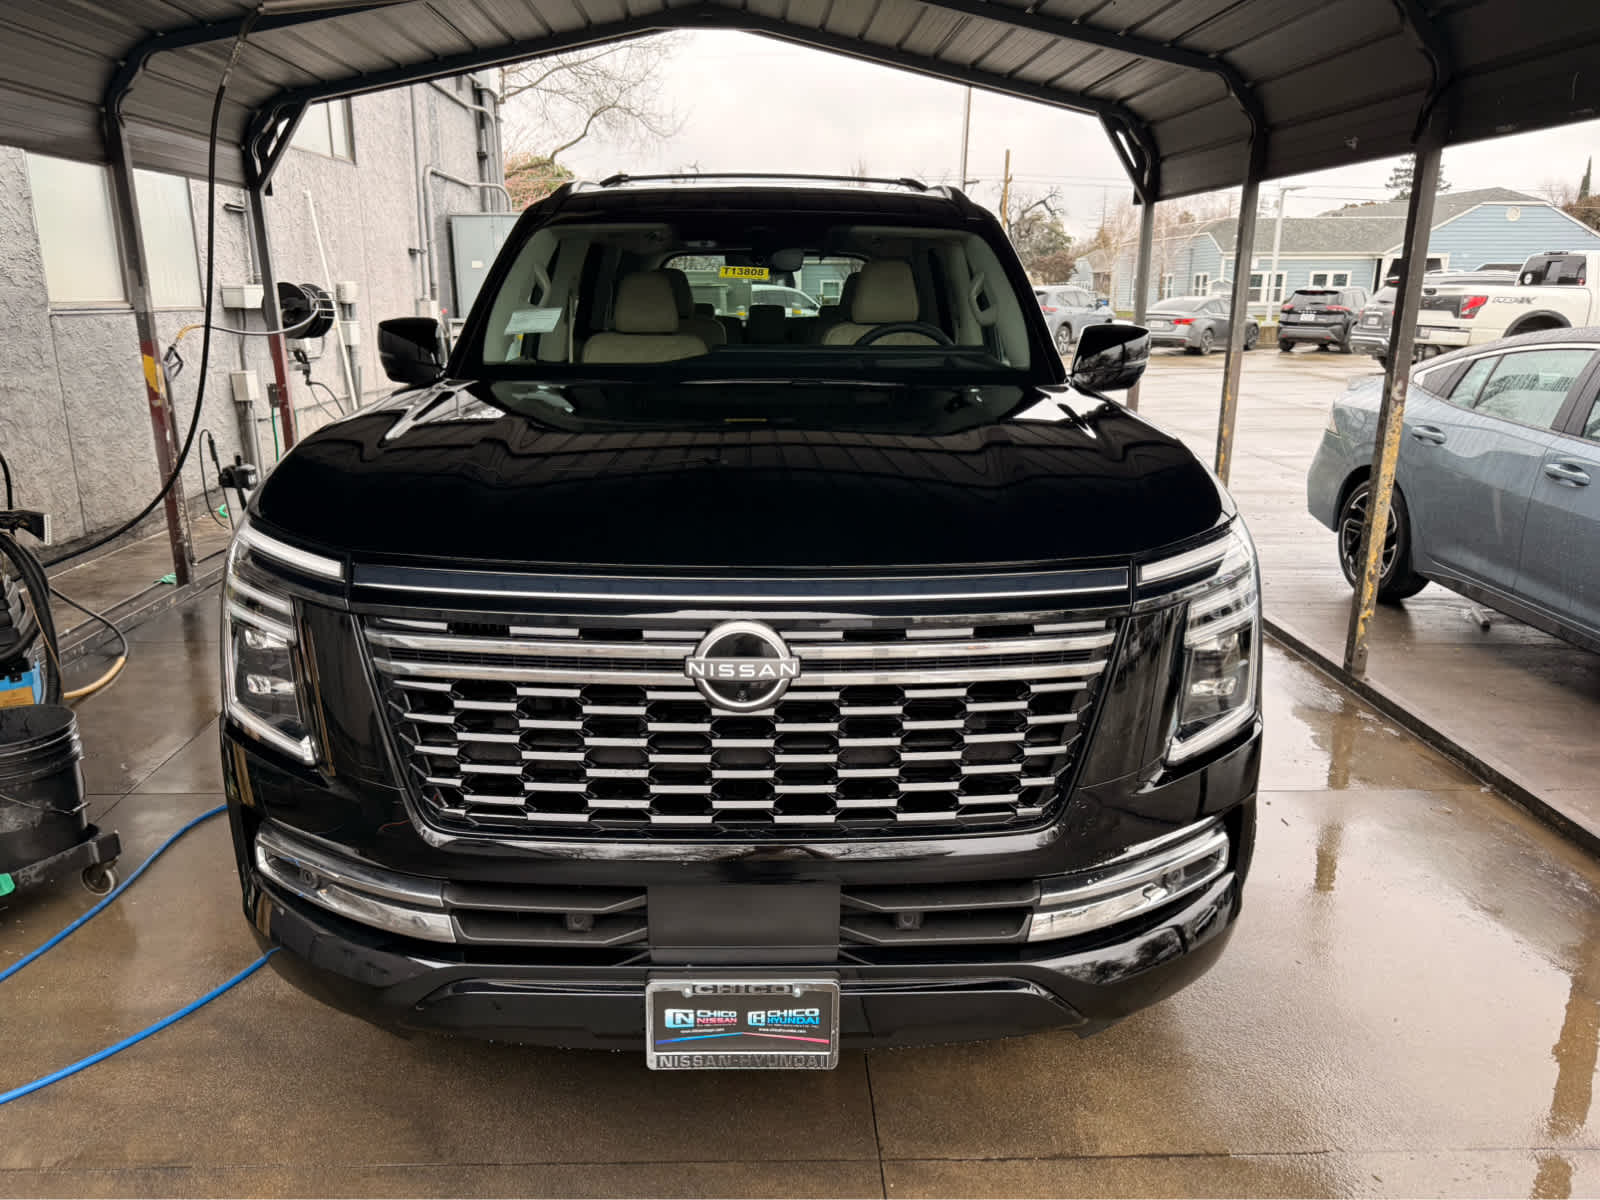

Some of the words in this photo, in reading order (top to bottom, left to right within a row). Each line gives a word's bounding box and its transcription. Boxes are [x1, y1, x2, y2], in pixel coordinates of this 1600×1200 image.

[688, 662, 796, 677] NISSAN
[767, 1008, 820, 1017] CHICO
[767, 1016, 820, 1025] HYUNDAI
